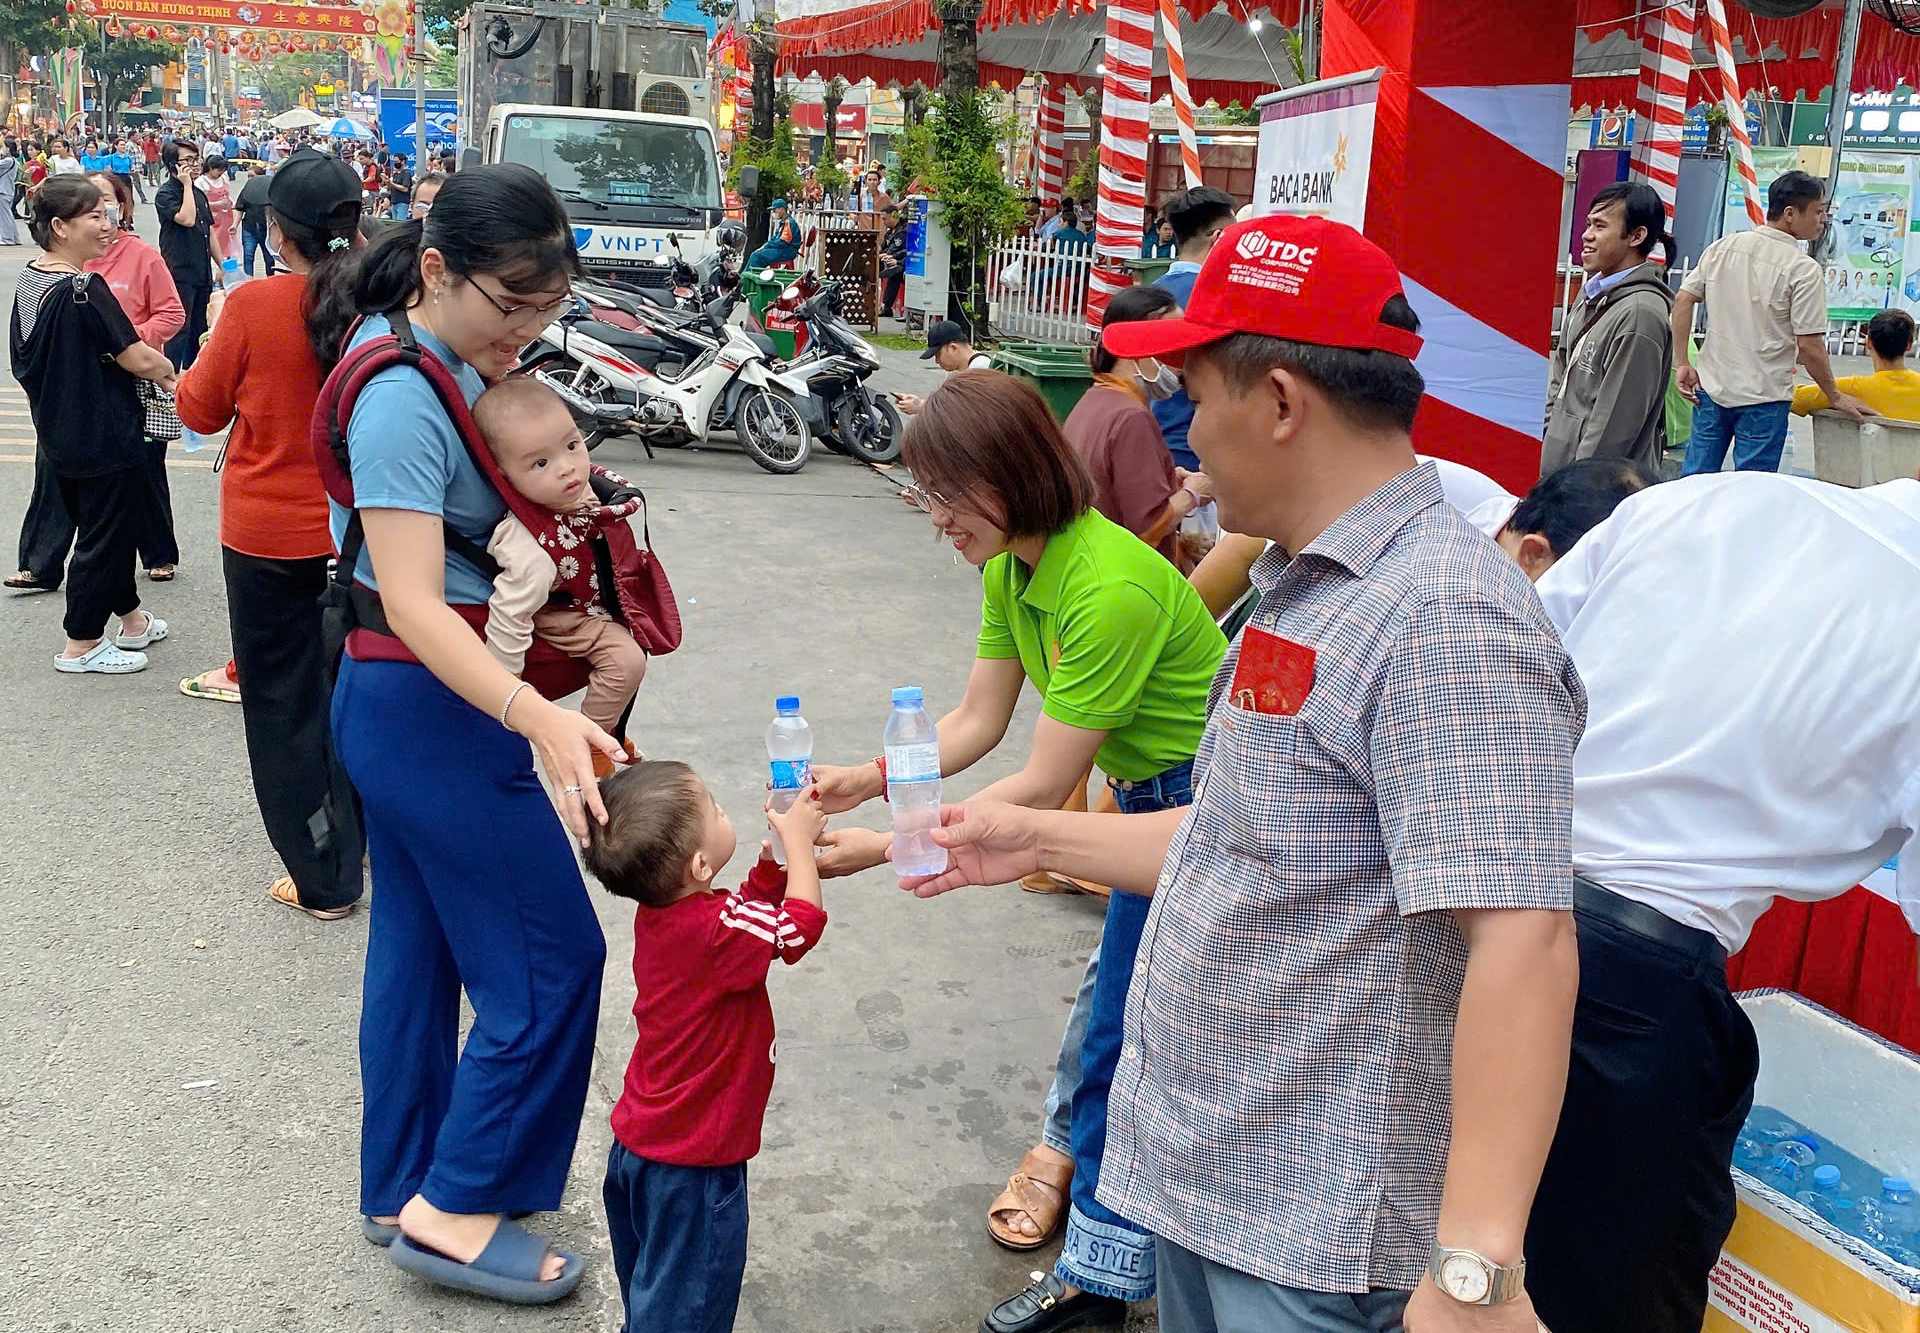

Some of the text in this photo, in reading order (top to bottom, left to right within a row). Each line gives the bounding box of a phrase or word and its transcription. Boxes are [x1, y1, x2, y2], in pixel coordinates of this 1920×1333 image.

[1301, 171, 1335, 204] BANK
[601, 235, 664, 253] VNPT
[1269, 240, 1314, 266] TDC
[1260, 258, 1309, 274] CORPORATION
[1088, 1241, 1140, 1273] STYLE
[1720, 1257, 1794, 1311] Signing Receipt
[1734, 1280, 1776, 1312] Contents
[1708, 1274, 1791, 1333] Package Damage
[1714, 1290, 1746, 1317] Broken
[1749, 1311, 1757, 1326] Is
[1779, 1306, 1810, 1333] Check
